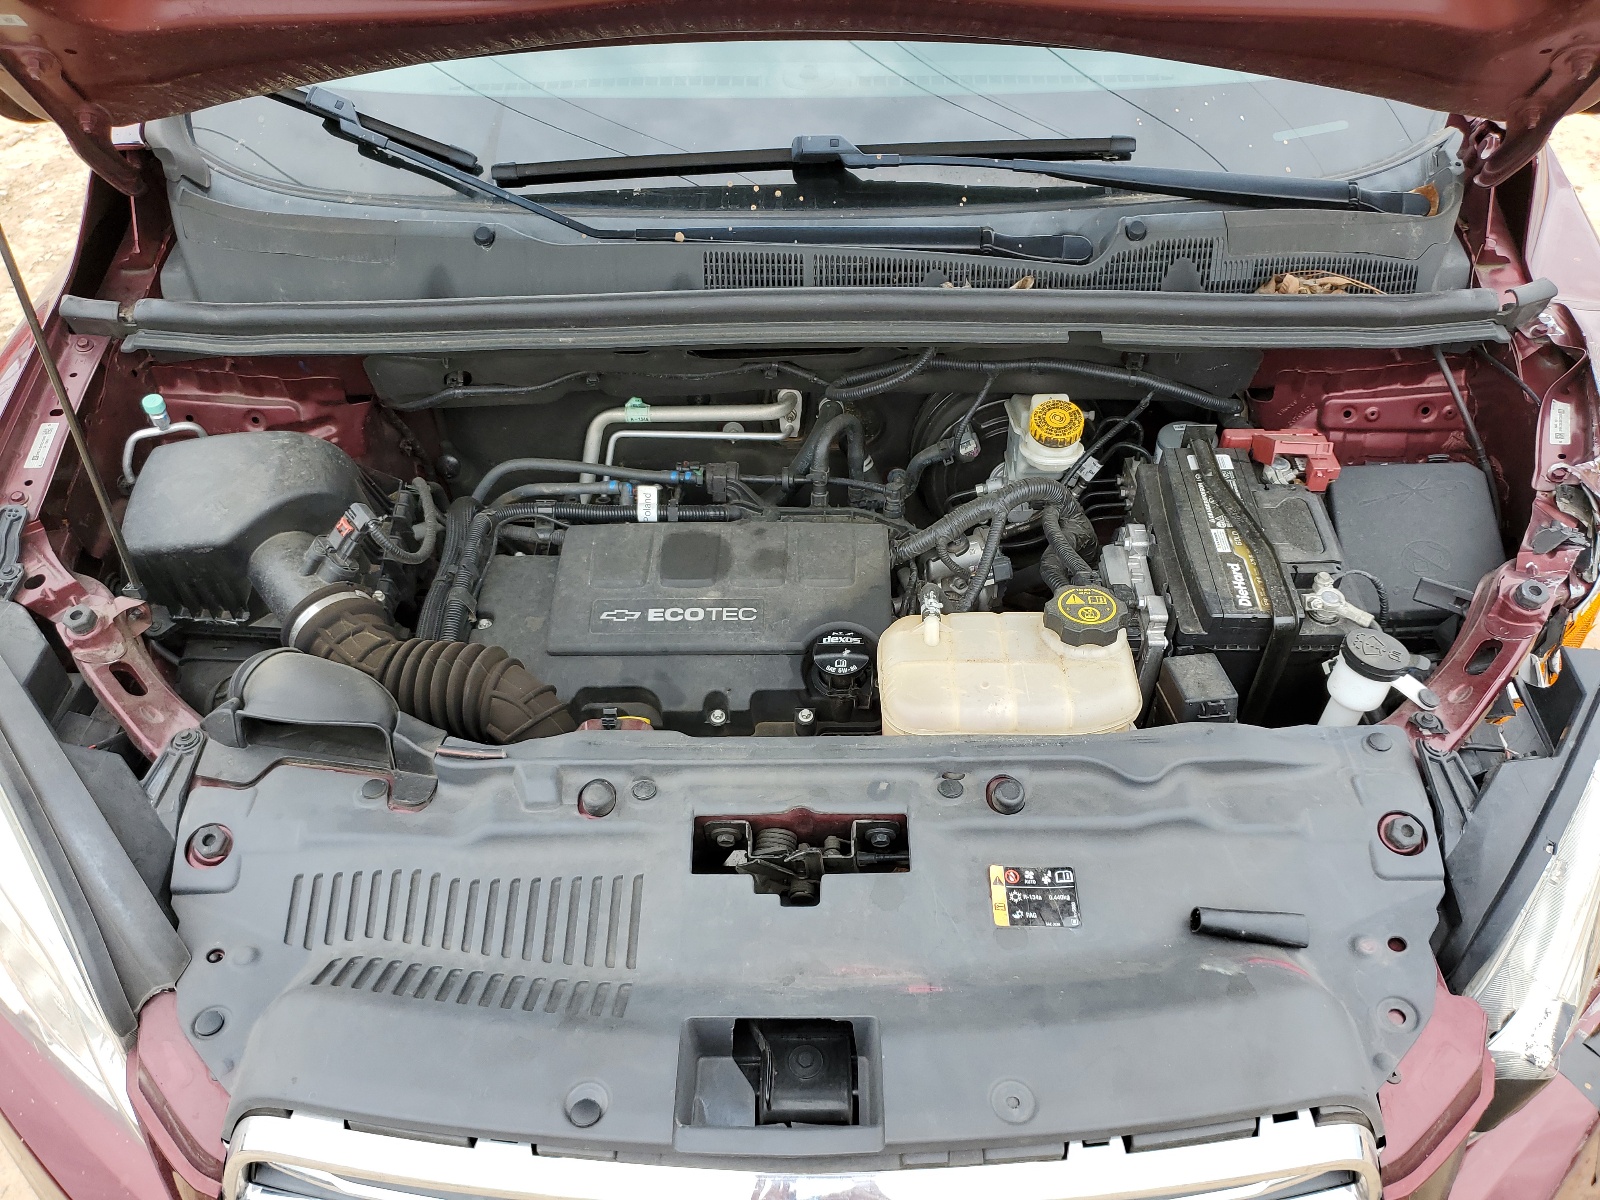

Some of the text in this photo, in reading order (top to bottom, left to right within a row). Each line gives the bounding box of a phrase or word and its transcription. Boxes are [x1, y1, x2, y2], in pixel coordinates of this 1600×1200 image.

[642, 492, 652, 522] Poland
[1226, 562, 1253, 607] DieHard
[647, 607, 758, 622] ECOTEC
[822, 635, 863, 644] dexos
